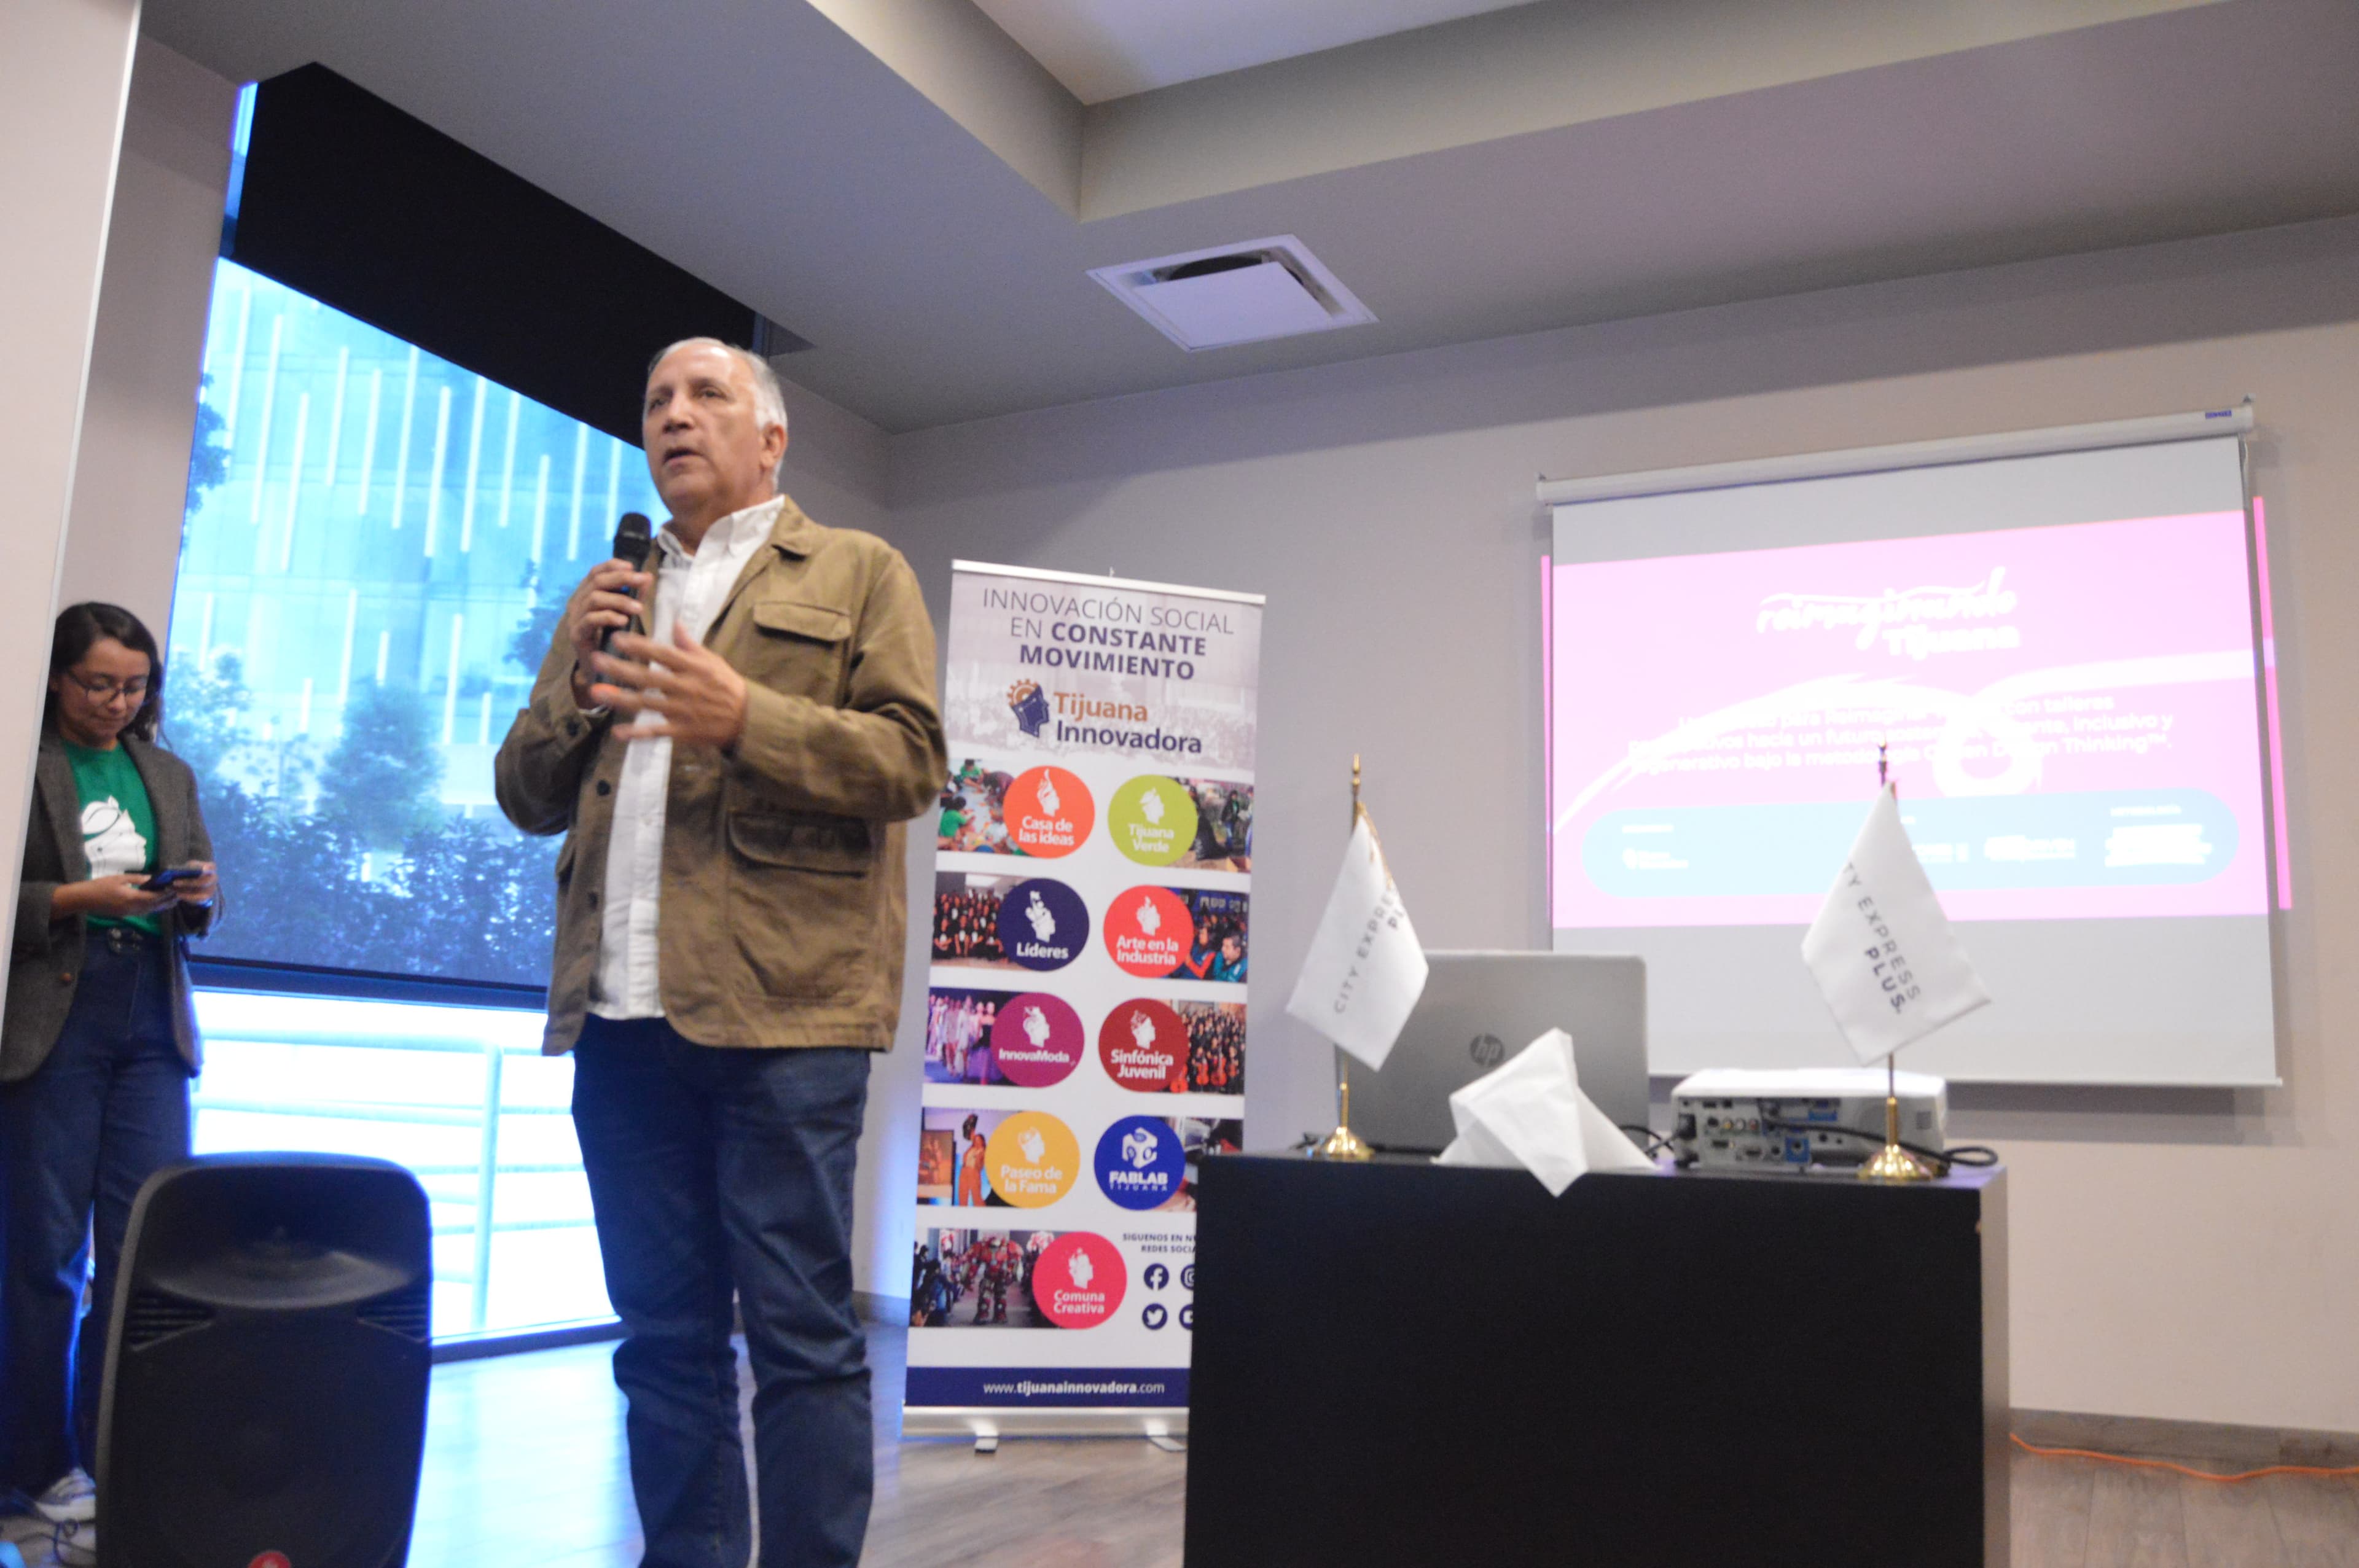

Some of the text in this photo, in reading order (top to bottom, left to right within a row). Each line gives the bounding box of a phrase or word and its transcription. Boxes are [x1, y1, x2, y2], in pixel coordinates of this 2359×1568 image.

[983, 588, 1234, 634] INNOVACIÓN SOCIAL
[1011, 617, 1207, 657] EN CONSTANTE
[1020, 644, 1194, 681] MOVIMIENTO
[1053, 692, 1148, 722] Tijuana
[1057, 720, 1202, 754] Innovadora
[1022, 815, 1073, 832] Casa de
[1019, 828, 1037, 844] las
[1128, 824, 1175, 841] Tijuana
[1132, 839, 1170, 853] Verde
[1017, 942, 1068, 959] Líderes
[1117, 935, 1179, 953] Arte en la
[1857, 896, 1921, 1000] EXPRESS
[1117, 948, 1176, 965] Industria
[1864, 946, 1907, 1015] PLUS
[1334, 965, 1358, 1014] CITY
[999, 1048, 1070, 1063] InnovaModa
[1111, 1048, 1173, 1066] Sinfónica
[1117, 1064, 1167, 1079] Juvenil
[1001, 1164, 1062, 1180] Paseo de
[1109, 1171, 1168, 1185] FABLAB
[1005, 1179, 1057, 1195] la Fama
[1171, 1234, 1183, 1242] EN
[1054, 1289, 1105, 1302] Comuna
[1054, 1301, 1105, 1314] Creativa
[983, 1381, 1165, 1397] www.tijuanainnovadora.com
